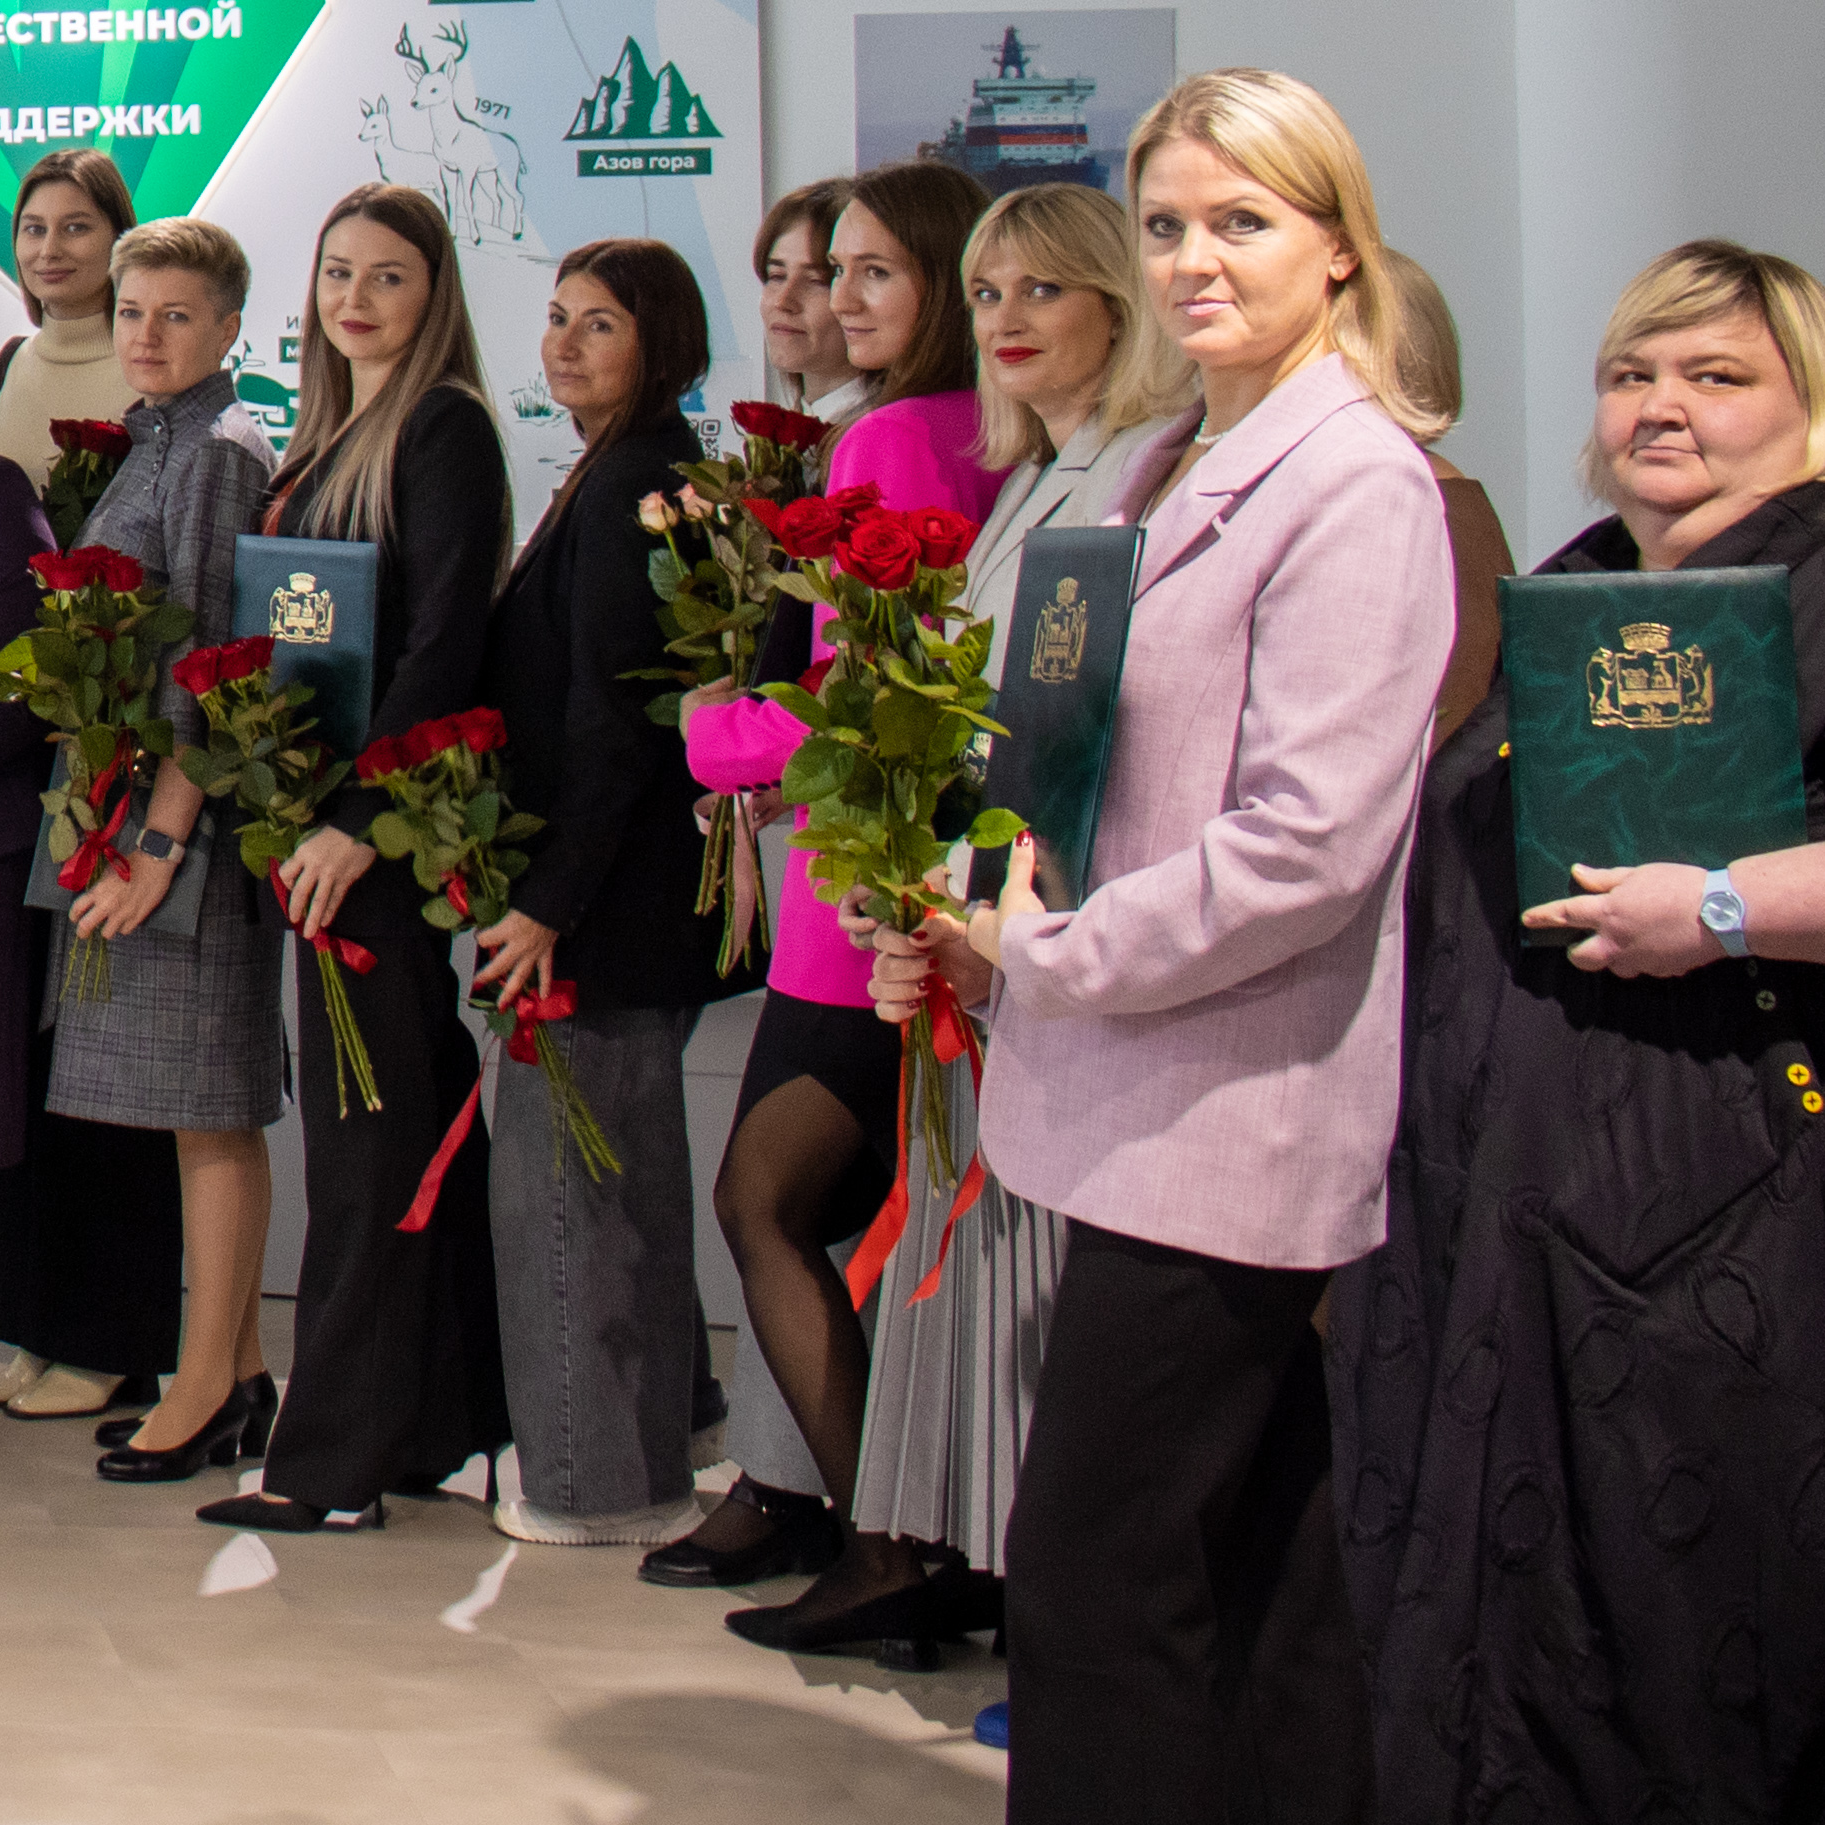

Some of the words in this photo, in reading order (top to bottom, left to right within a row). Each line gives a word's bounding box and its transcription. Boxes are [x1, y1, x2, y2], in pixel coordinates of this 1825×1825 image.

[473, 97, 511, 120] 1971
[593, 154, 644, 171] Азов
[649, 157, 696, 173] гора
